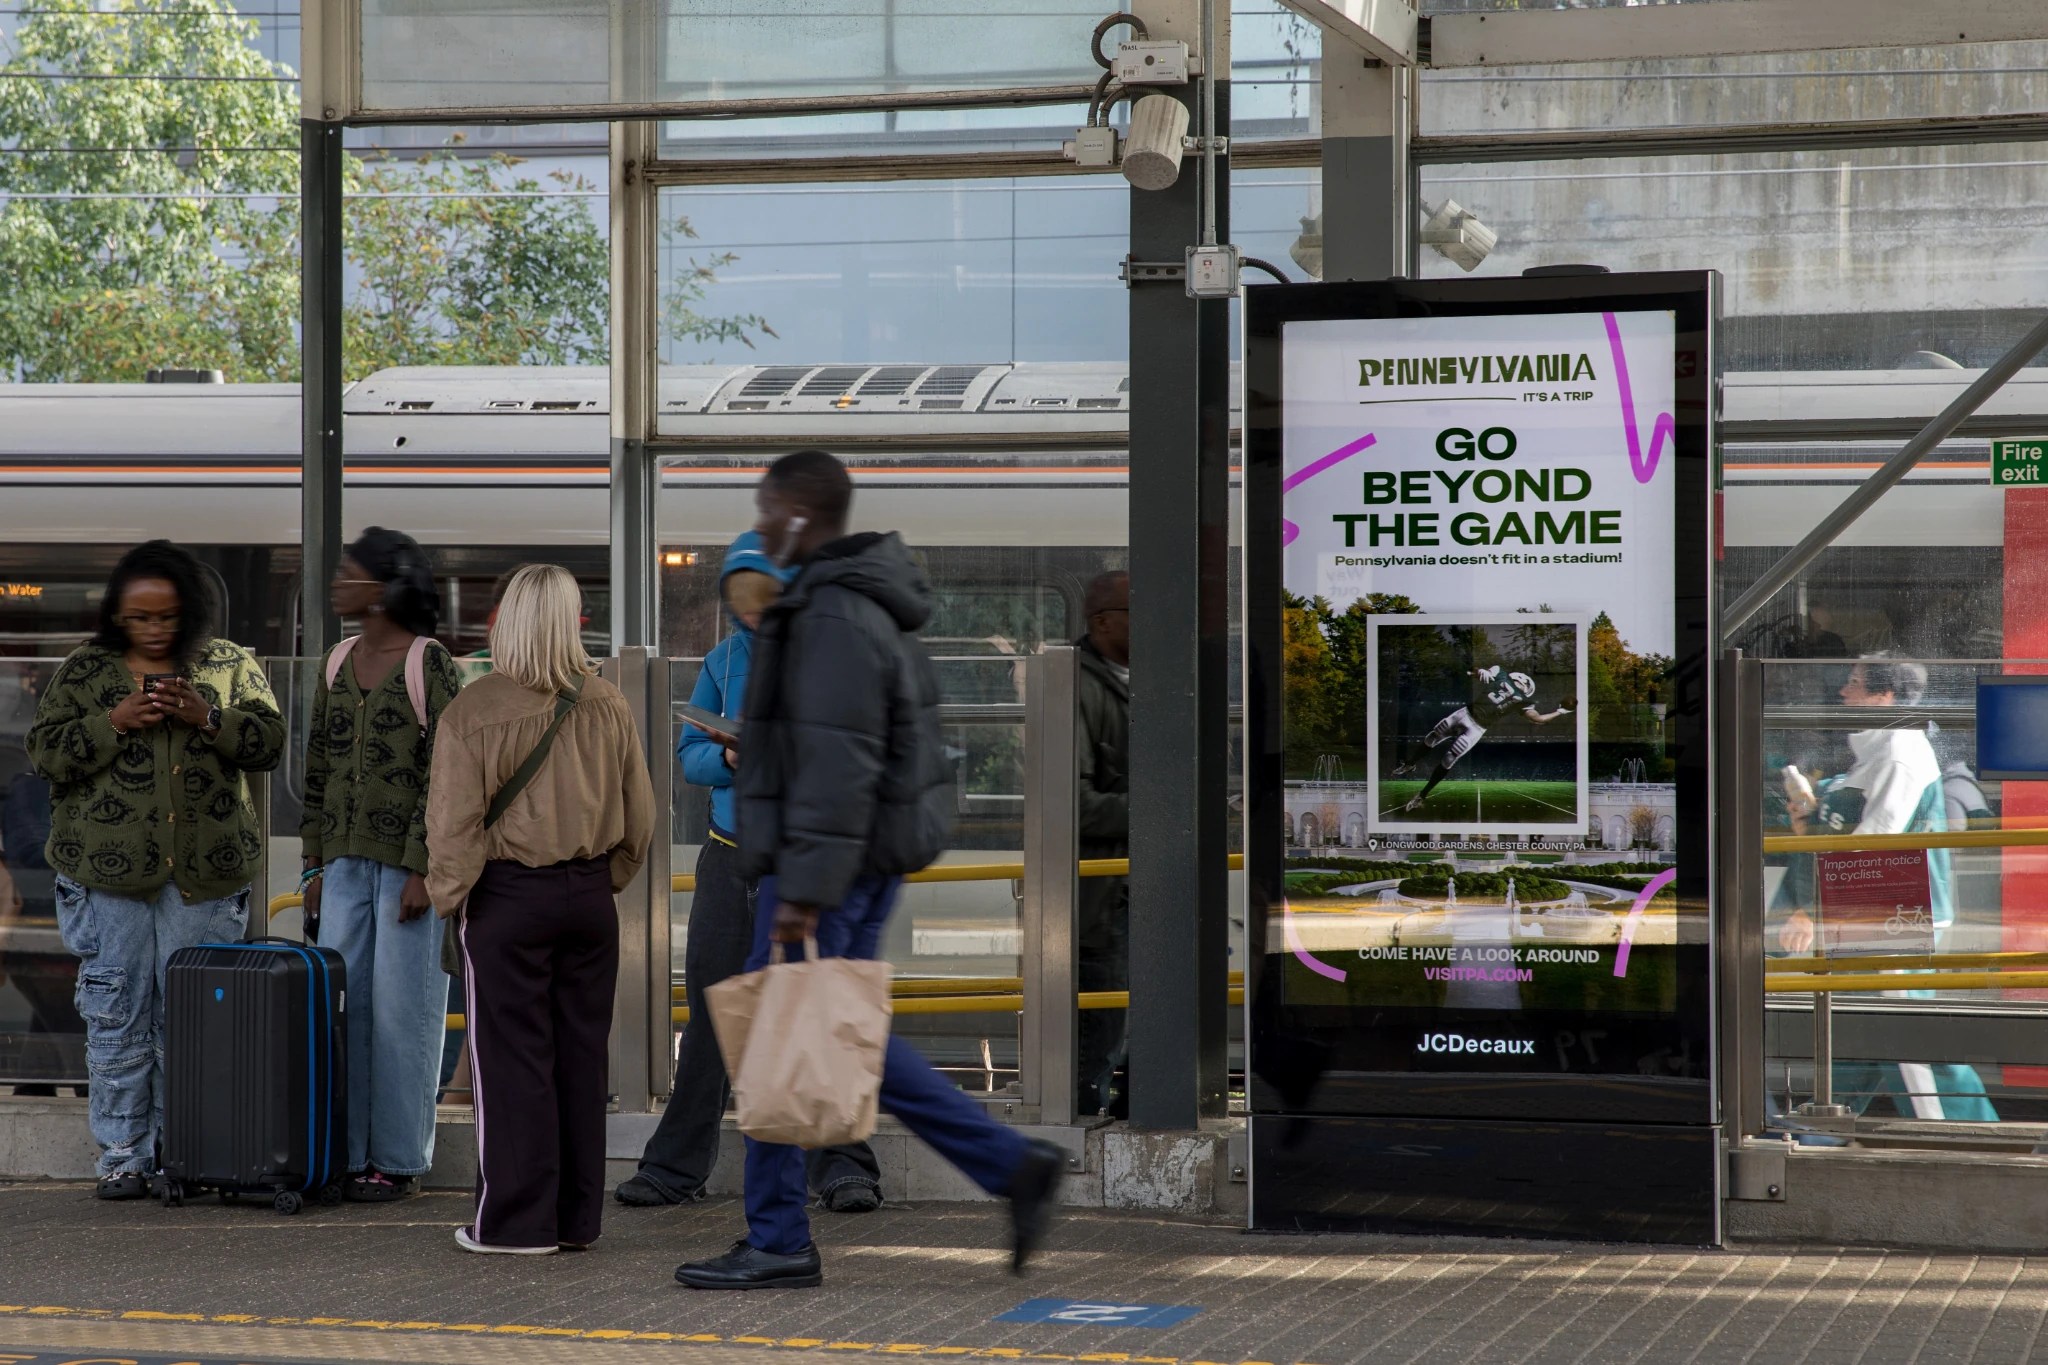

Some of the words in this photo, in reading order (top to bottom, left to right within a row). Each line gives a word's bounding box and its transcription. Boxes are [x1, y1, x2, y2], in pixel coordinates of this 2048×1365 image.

[1358, 353, 1597, 387] PENNSYLVANIA
[1523, 392, 1548, 402] IT'S
[1550, 392, 1561, 402] A
[1563, 391, 1594, 401] TRIP
[1435, 426, 1518, 462] GO
[2002, 443, 2043, 461] Fire
[2001, 464, 2040, 482] exit
[1363, 468, 1592, 505] BEYOND
[1332, 513, 1440, 548] THE
[1450, 510, 1622, 547] GAME
[1335, 555, 1436, 568] Pennsylvania
[1439, 553, 1499, 565] doesn't
[1501, 553, 1521, 565] fit
[1523, 553, 1538, 564] in
[1540, 555, 1550, 564] a
[1552, 552, 1623, 564] stadium!
[8, 583, 43, 596] Water
[1381, 841, 1436, 850] LONGWOOD
[1437, 841, 1485, 851] GARDENS,
[1486, 842, 1529, 850] CHESTER
[1573, 842, 1586, 850] PA
[1824, 856, 1881, 871] Important
[1885, 855, 1921, 866] notice
[1825, 873, 1837, 882] to
[1840, 869, 1884, 882] cyclists.
[1358, 947, 1408, 960] COME
[1412, 947, 1457, 961] HAVE
[1461, 948, 1473, 961] A
[1477, 948, 1522, 962] LOOK
[1525, 949, 1600, 963] AROUND
[1423, 967, 1533, 982] VISITPA.COM
[1417, 1033, 1535, 1054] JCDecaux
